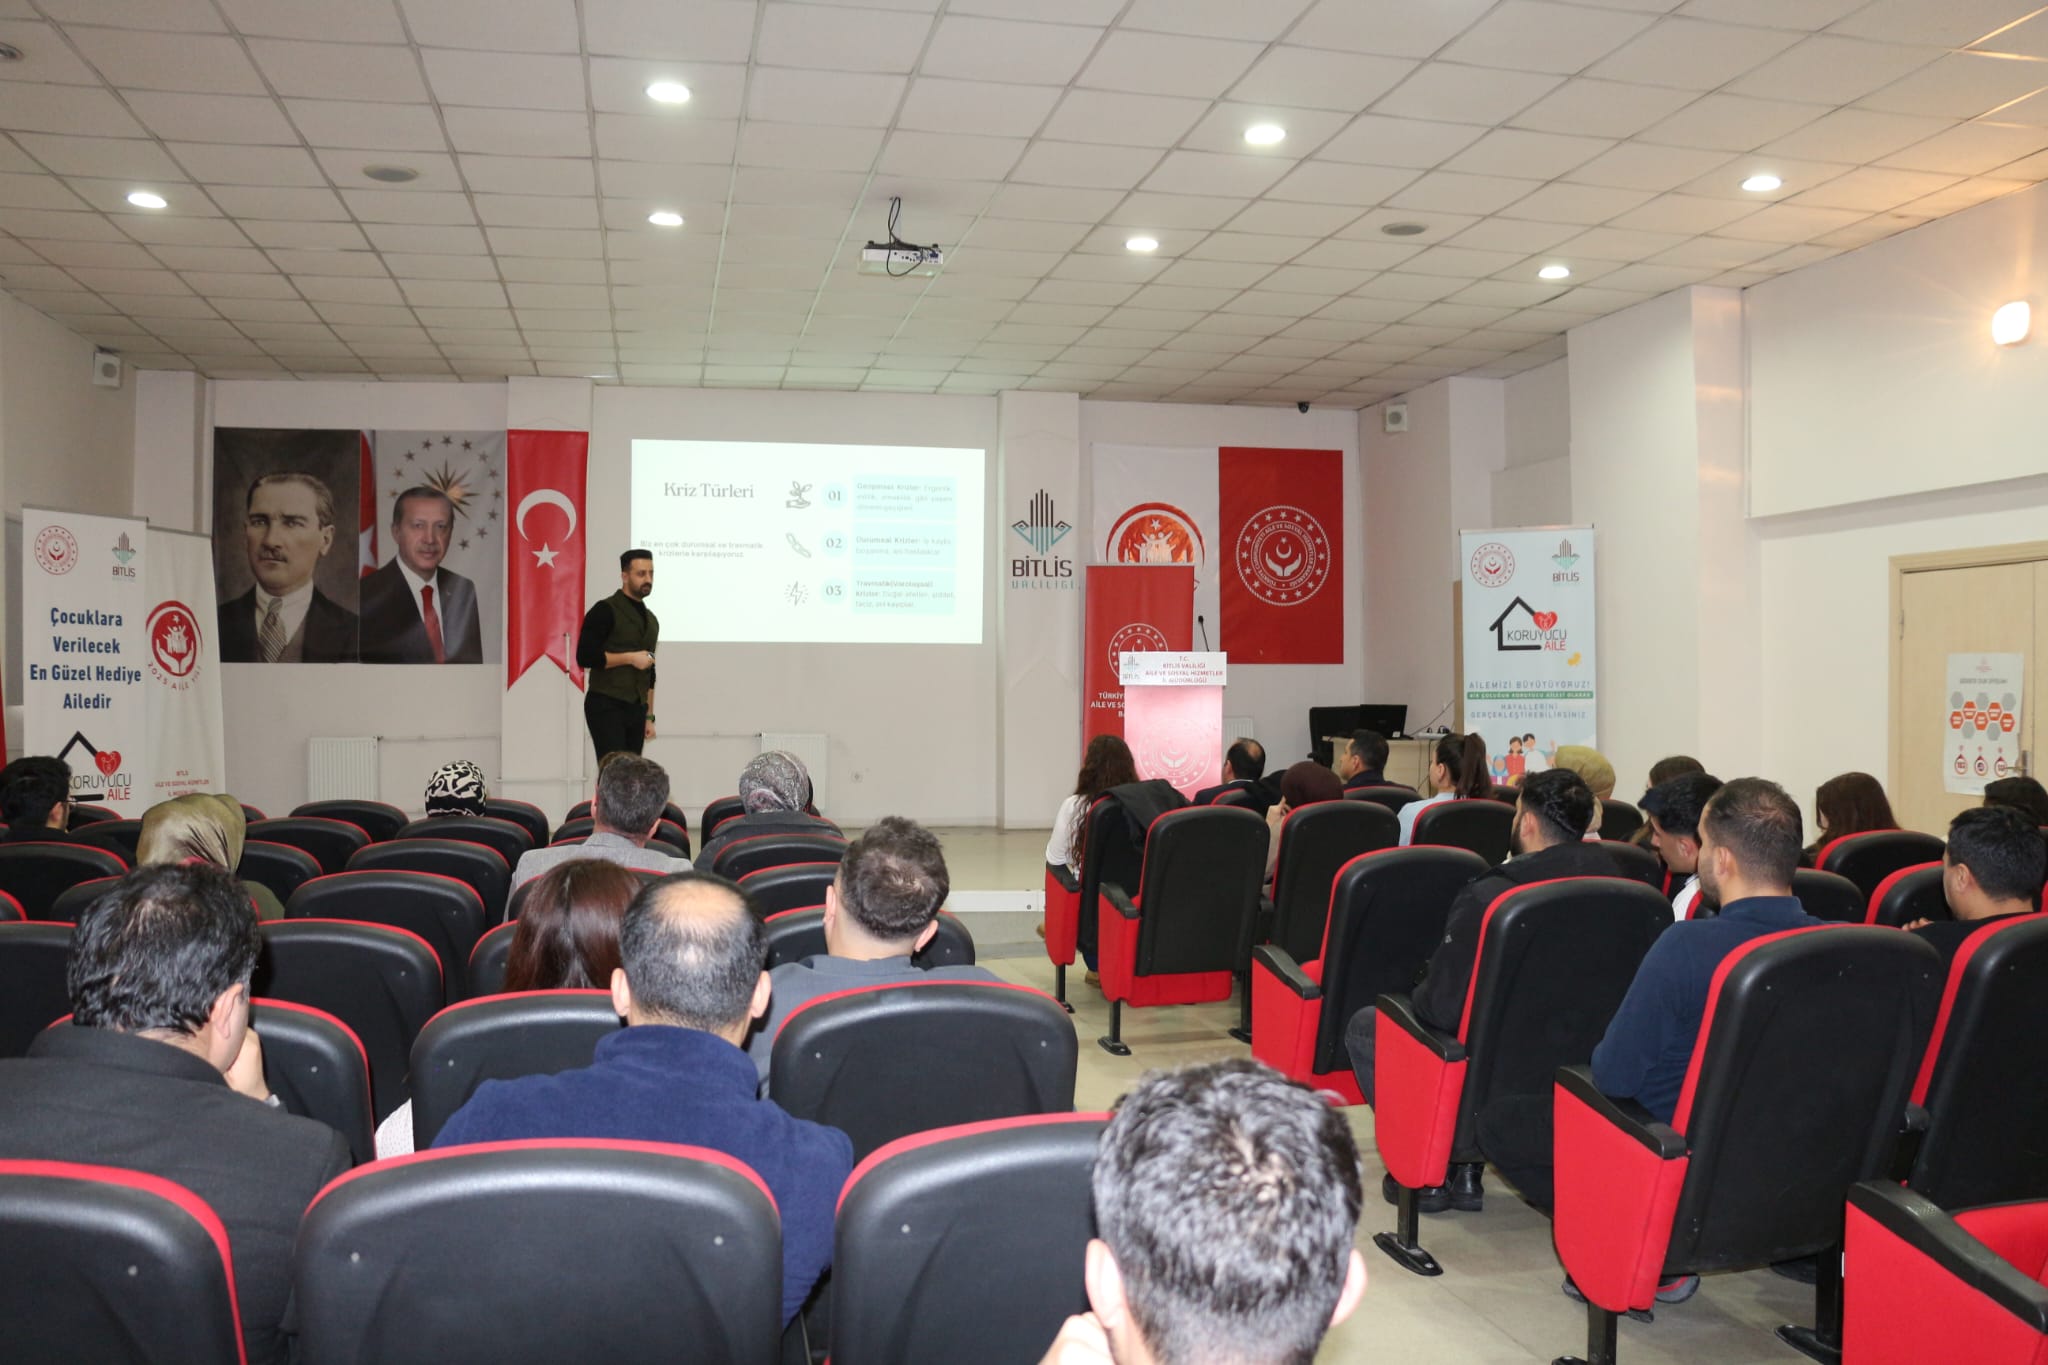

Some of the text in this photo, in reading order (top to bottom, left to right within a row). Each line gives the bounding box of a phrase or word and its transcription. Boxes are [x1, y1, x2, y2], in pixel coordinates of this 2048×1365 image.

[664, 482, 754, 499] Kriz Türleri
[828, 490, 841, 502] 01
[826, 537, 842, 549] 02
[112, 564, 136, 577] BİTLİS
[1012, 555, 1072, 577] BİTLİS
[1552, 572, 1580, 582] BİTLİS
[826, 584, 842, 596] 03
[50, 607, 123, 627] Çocuklara
[1507, 629, 1567, 641] KORUYUCU
[53, 636, 121, 654] Verilecek
[30, 664, 142, 685] En Güzel Hediye
[63, 693, 112, 709] Ailedir
[1098, 691, 1125, 699] TÜRKİY
